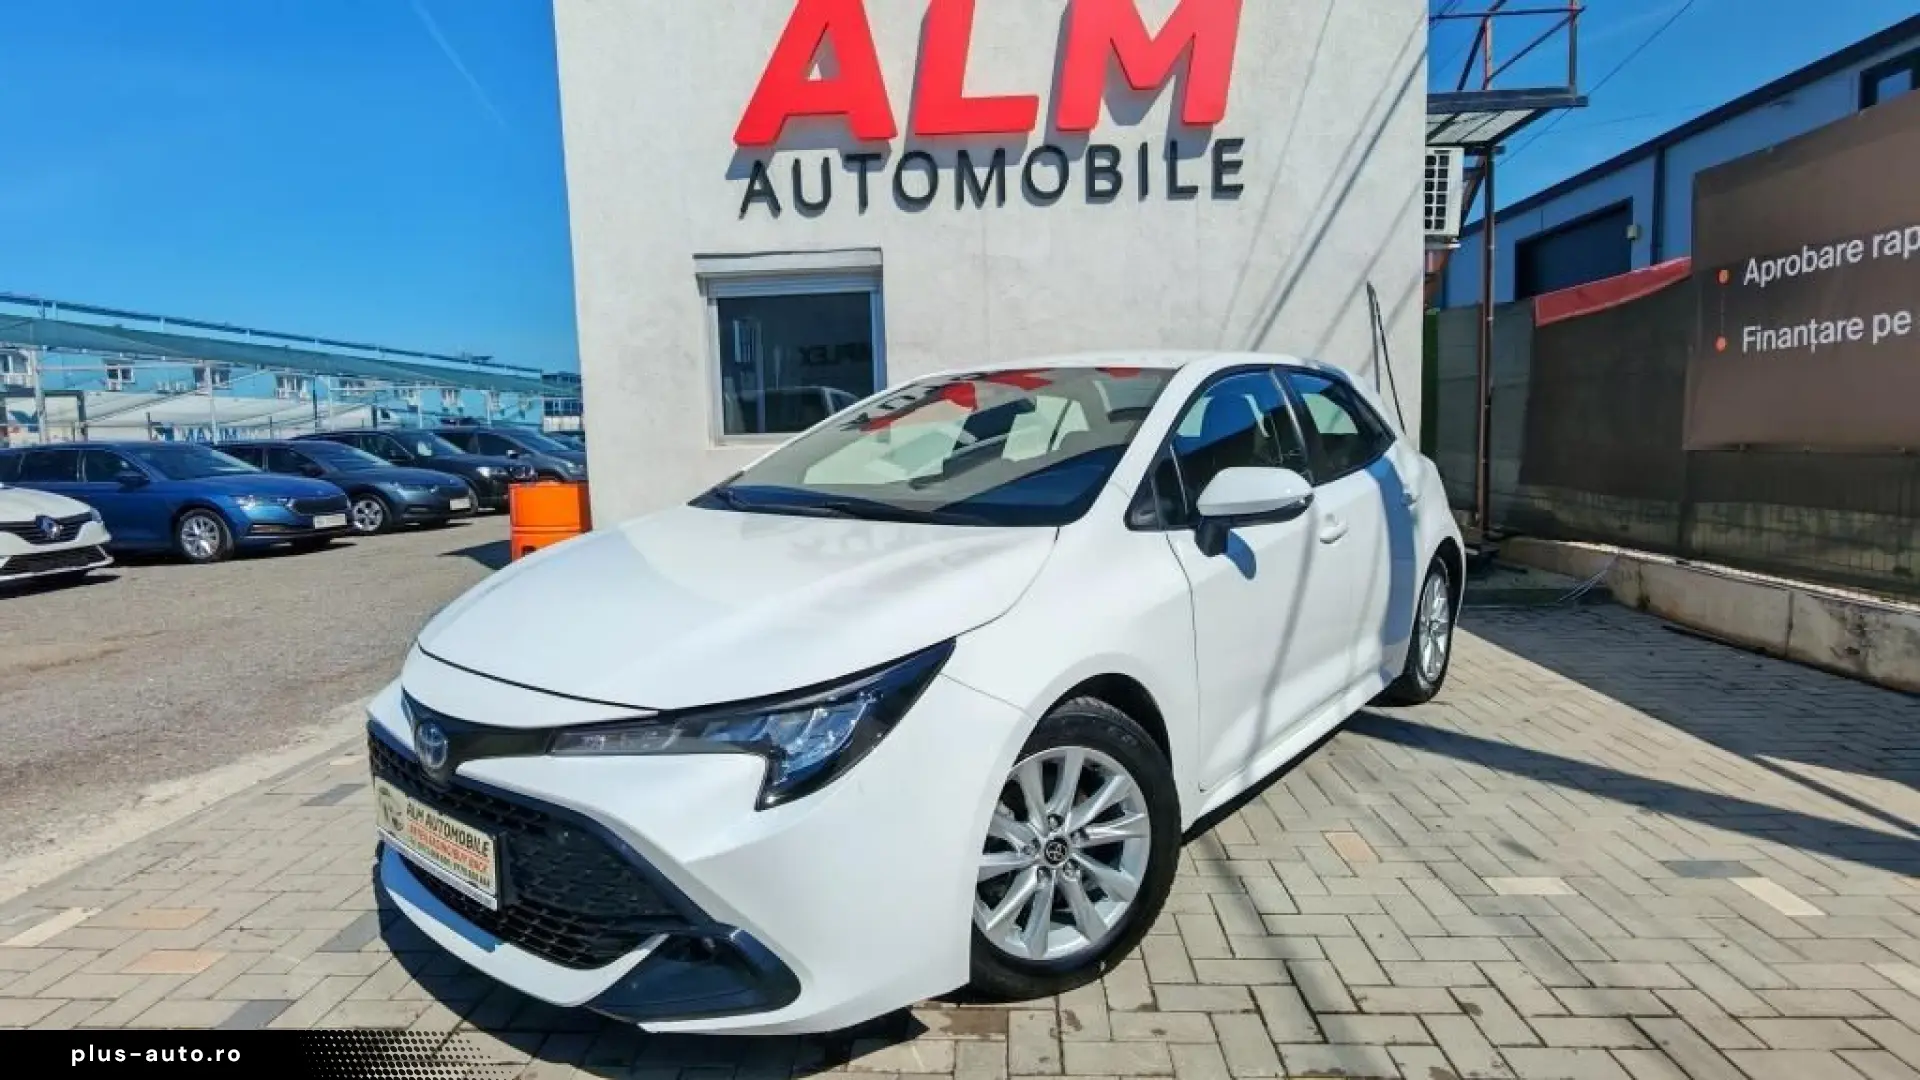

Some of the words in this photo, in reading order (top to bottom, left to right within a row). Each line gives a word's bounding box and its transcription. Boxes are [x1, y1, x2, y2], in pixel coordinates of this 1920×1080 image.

[733, 0, 1243, 147] ALM
[739, 137, 1245, 220] AUTOMOBILE
[1743, 239, 1866, 288] Aprobare
[1741, 316, 1866, 354] Finanțare
[1872, 309, 1913, 346] pe
[425, 812, 490, 858] AUTOMOBILE
